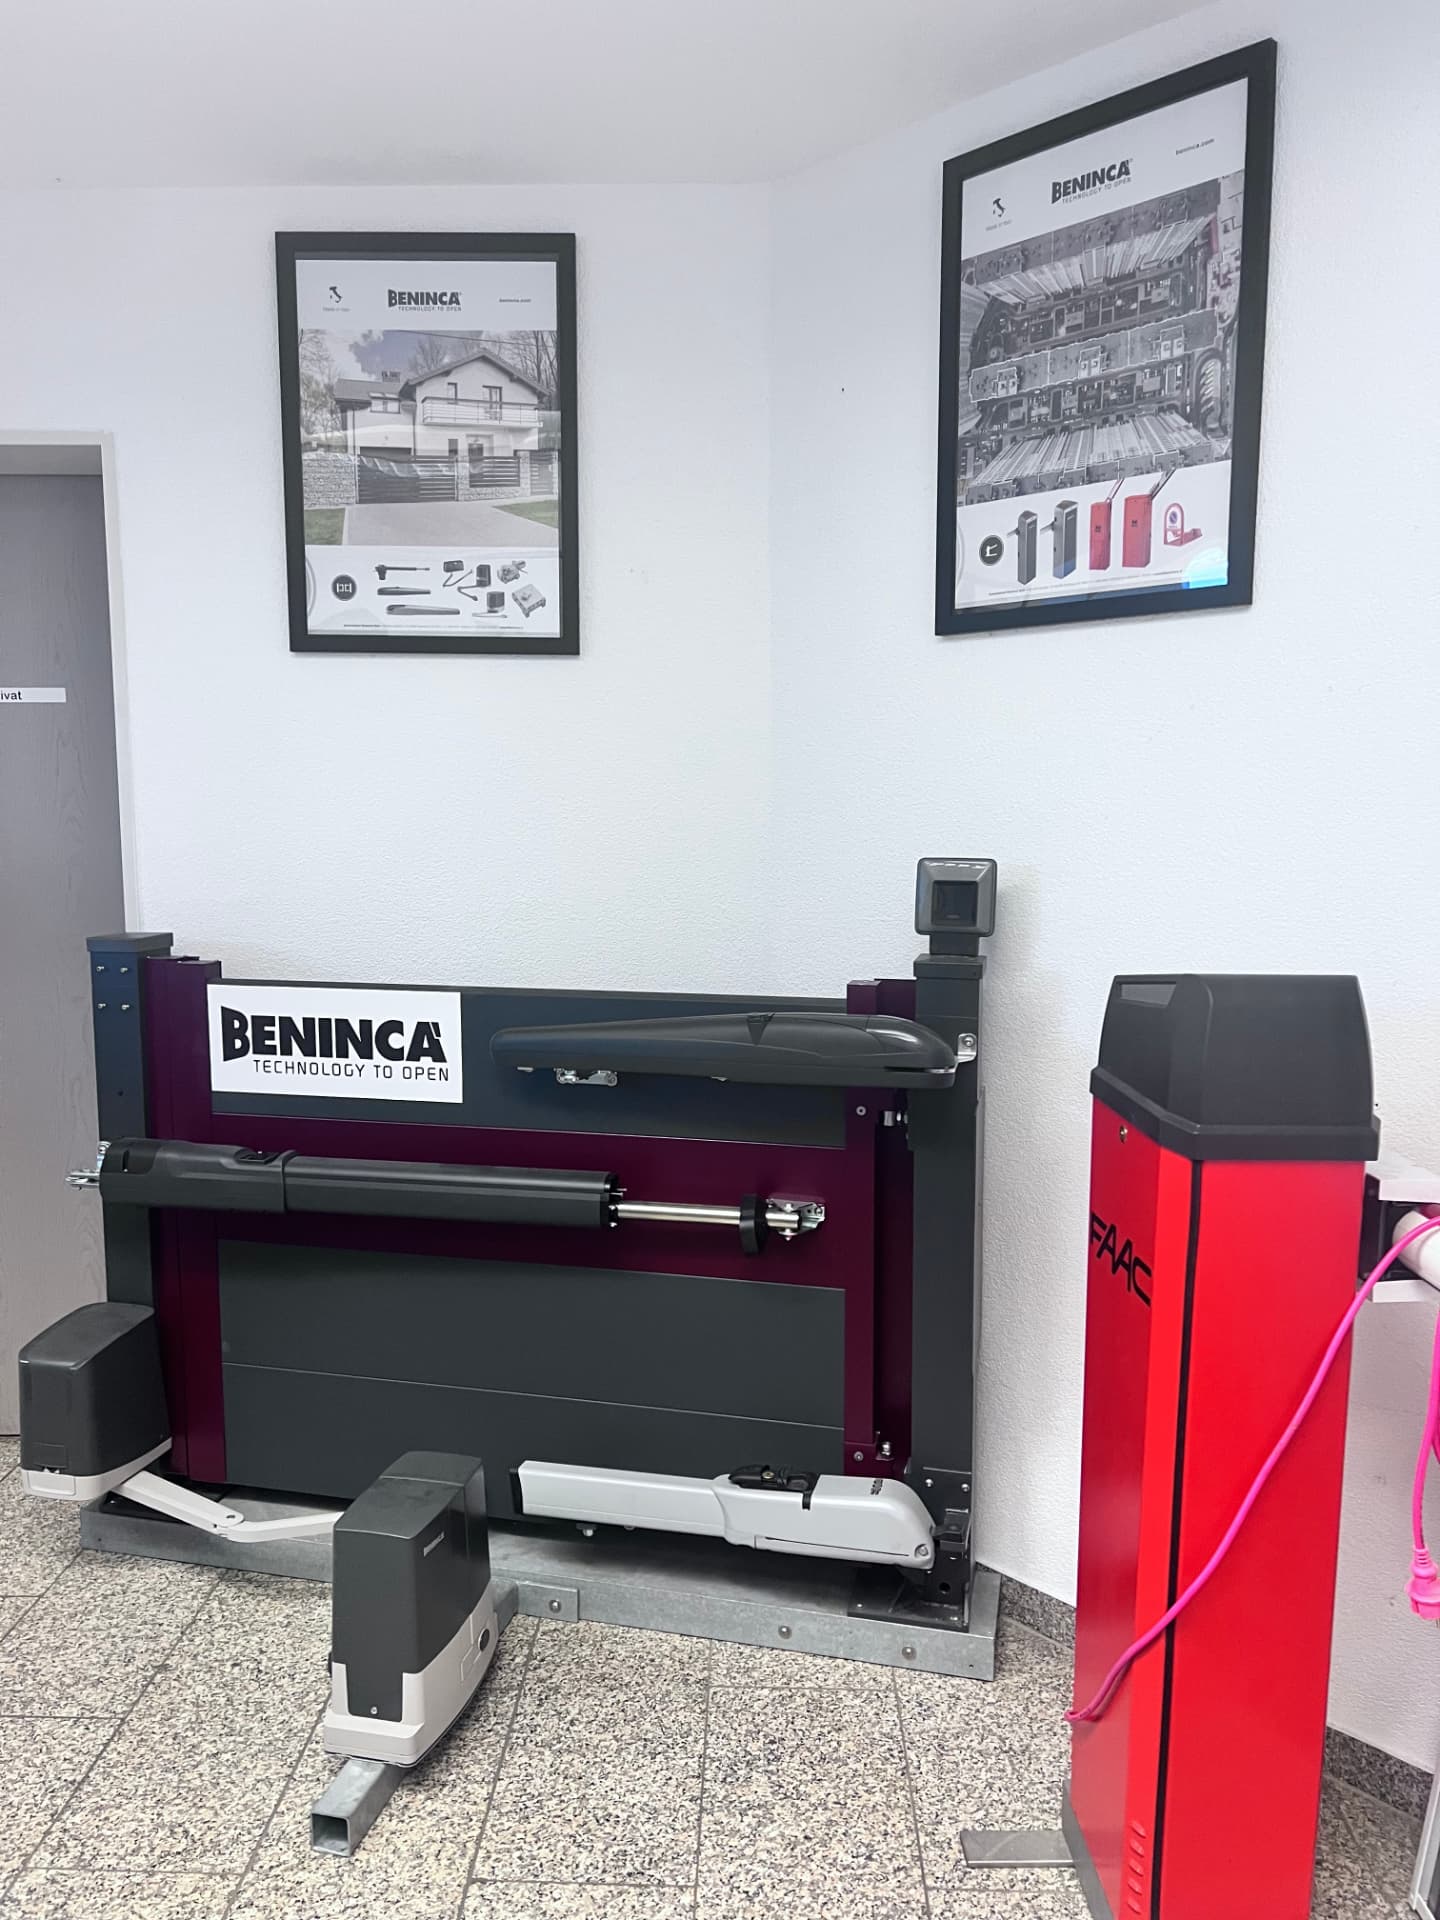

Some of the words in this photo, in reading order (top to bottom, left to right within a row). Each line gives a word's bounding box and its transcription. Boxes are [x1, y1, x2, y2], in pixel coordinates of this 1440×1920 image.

[253, 1059, 366, 1078] TECHNOLOGY
[373, 1064, 393, 1079] TO
[402, 1066, 449, 1082] OPEN
[1090, 1212, 1153, 1307] FAAC
